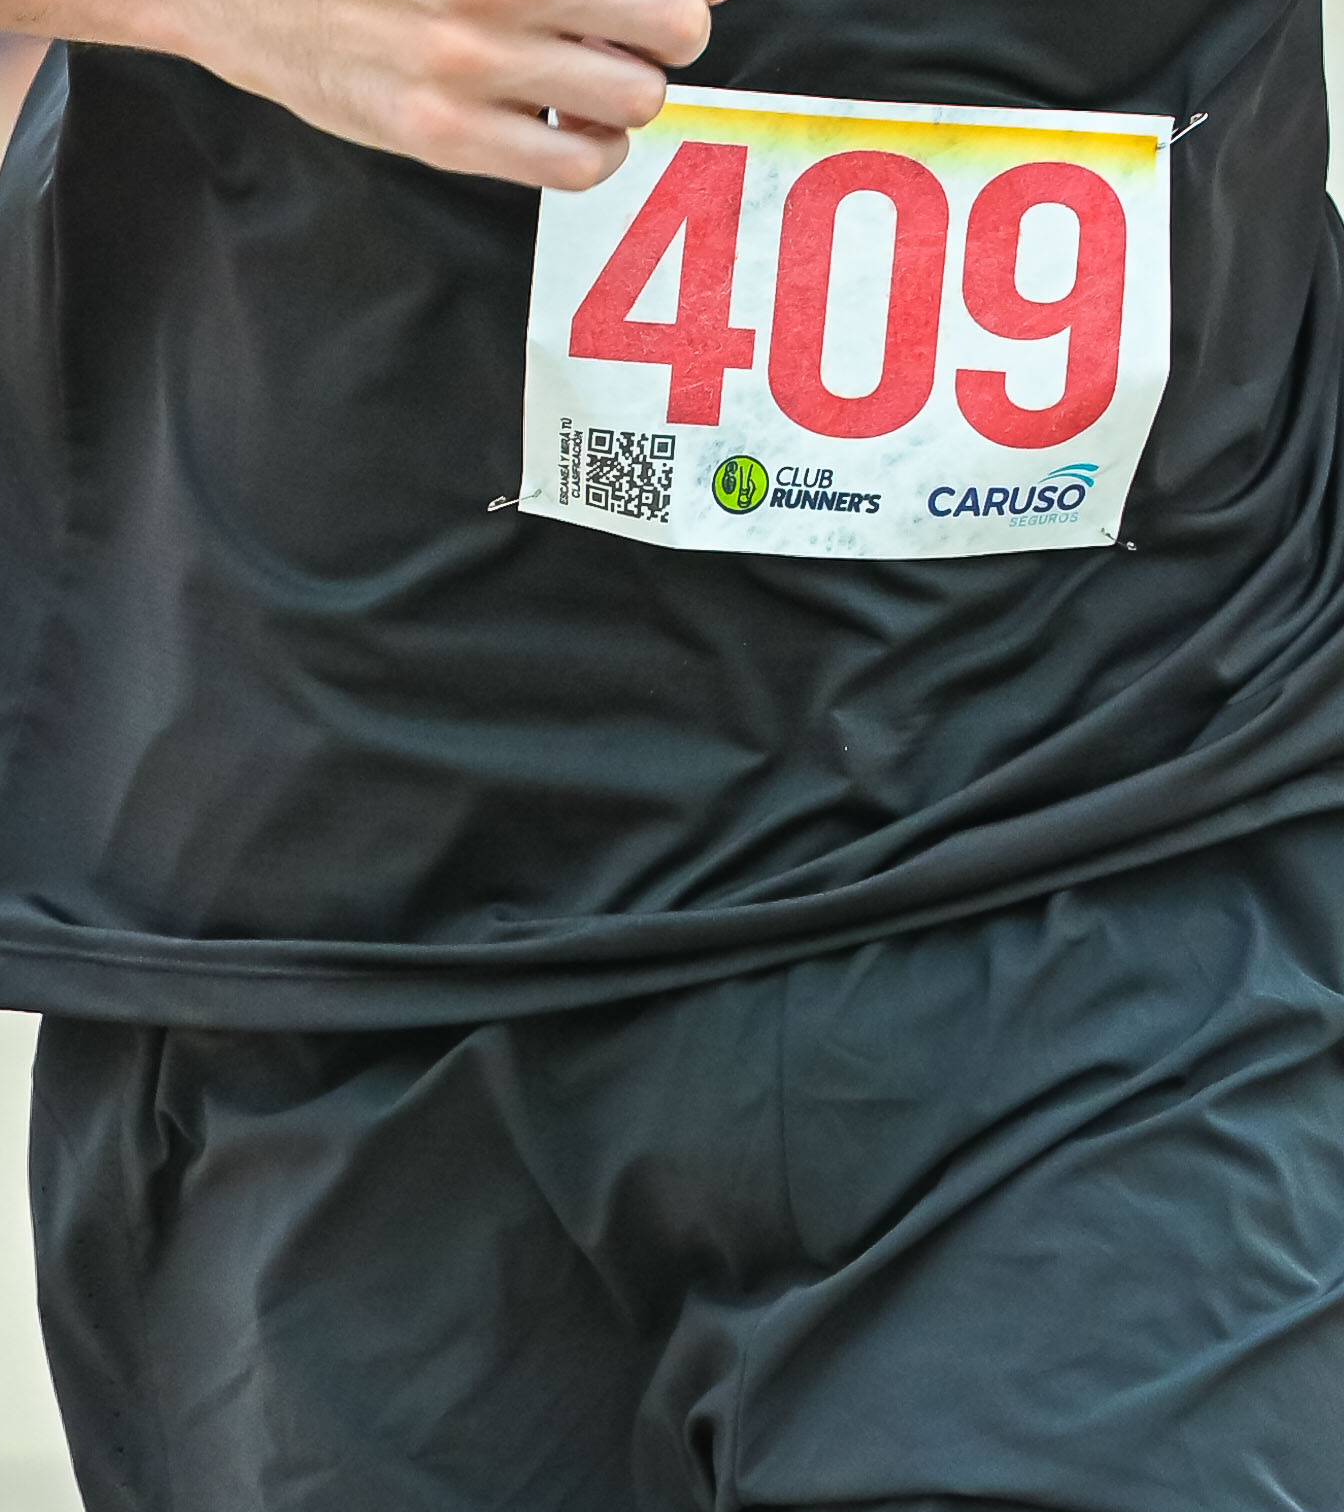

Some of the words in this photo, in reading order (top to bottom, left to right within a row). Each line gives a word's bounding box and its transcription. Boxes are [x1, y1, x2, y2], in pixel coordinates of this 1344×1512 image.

[568, 139, 1128, 450] 409
[776, 466, 834, 489] CLUB
[770, 488, 882, 514] RUNNER'S
[927, 483, 1086, 517] CARUSO
[1009, 511, 1079, 528] SEGUROS
